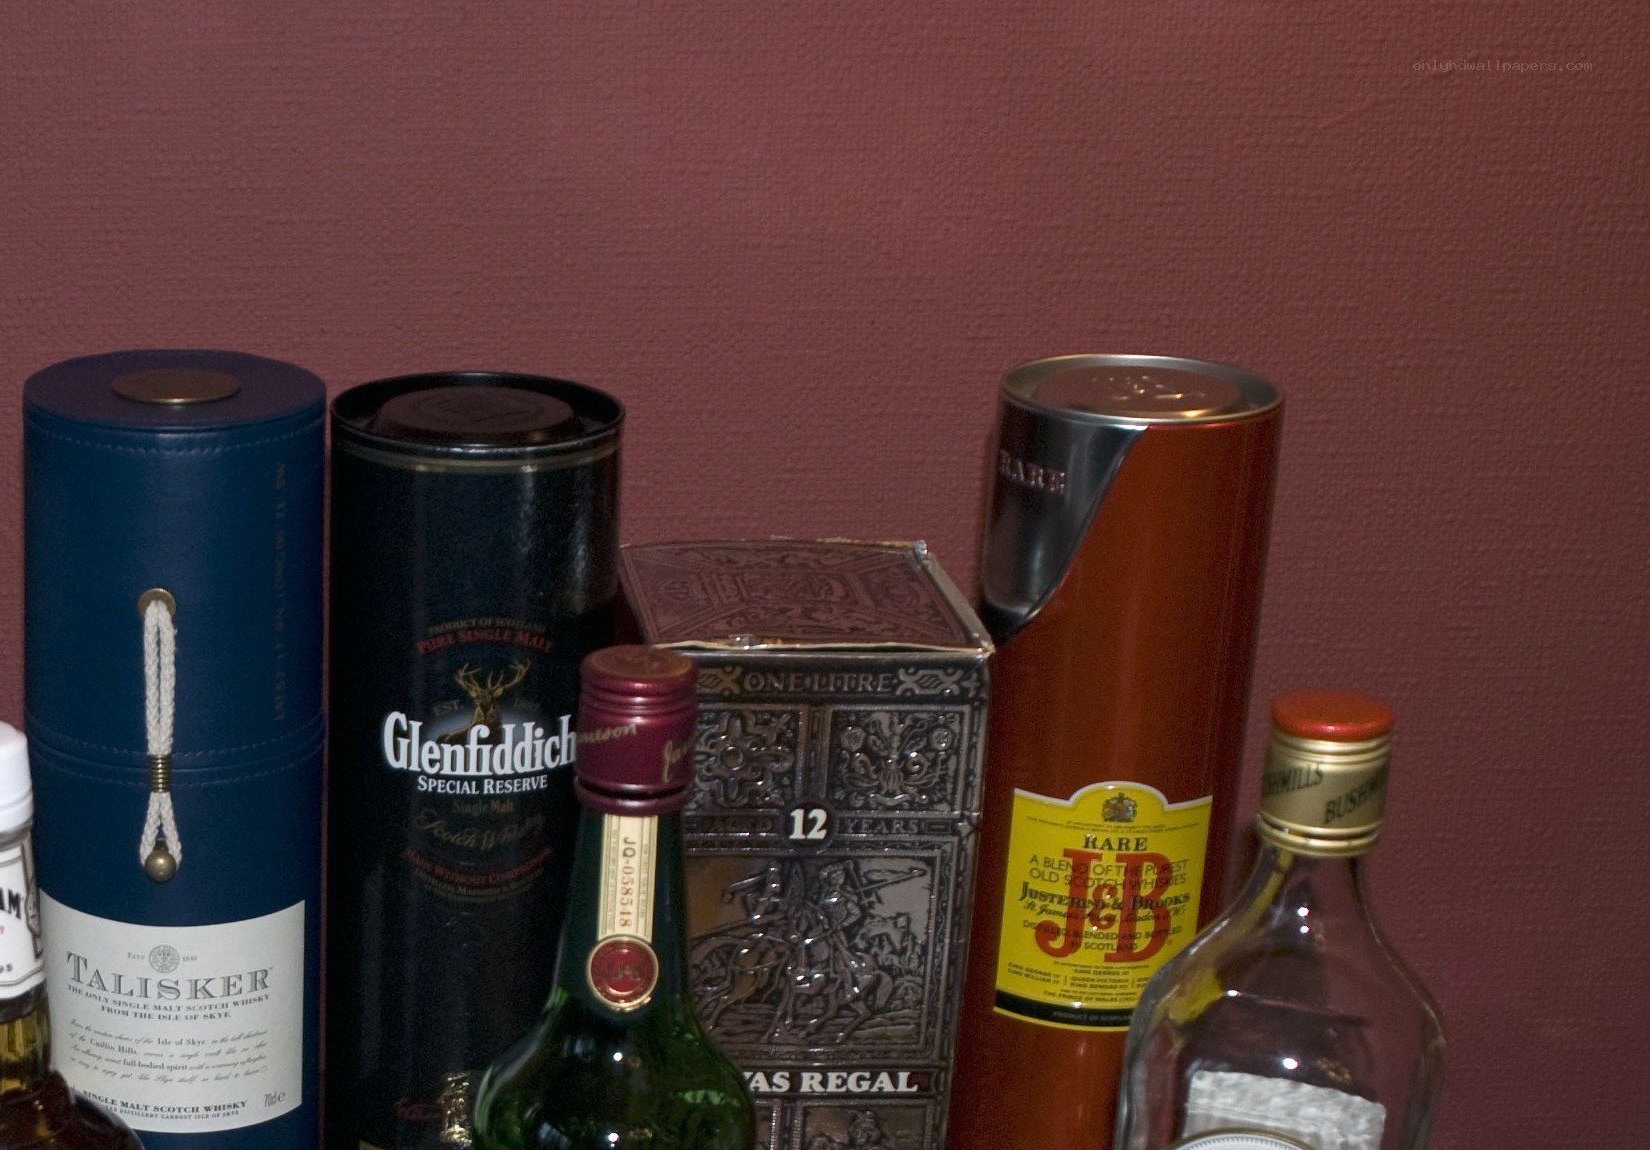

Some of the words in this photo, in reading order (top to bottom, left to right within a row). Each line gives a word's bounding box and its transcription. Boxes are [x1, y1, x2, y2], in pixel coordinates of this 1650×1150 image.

[382, 710, 578, 777] Glenfiddich
[416, 775, 480, 796] SPECIAL
[482, 774, 549, 795] RESERVE
[788, 807, 829, 842] 12
[1083, 834, 1149, 851] RARE
[1034, 847, 1175, 964] J&B
[66, 950, 271, 1001] TALISKER
[101, 1005, 130, 1018] FROM
[134, 1010, 155, 1020] THE
[157, 1011, 181, 1021] ISLE
[184, 1012, 200, 1021] OF
[202, 1009, 232, 1020] SKYE
[112, 997, 150, 1012] SINGLE
[153, 1003, 183, 1013] MALT
[186, 1002, 229, 1013] SCOTCH
[231, 993, 271, 1008] WHISKY
[799, 1071, 920, 1093] REGAL
[119, 1098, 151, 1113] MALT
[153, 1103, 201, 1115] SCOTCH
[204, 1099, 248, 1114] WHISKY
